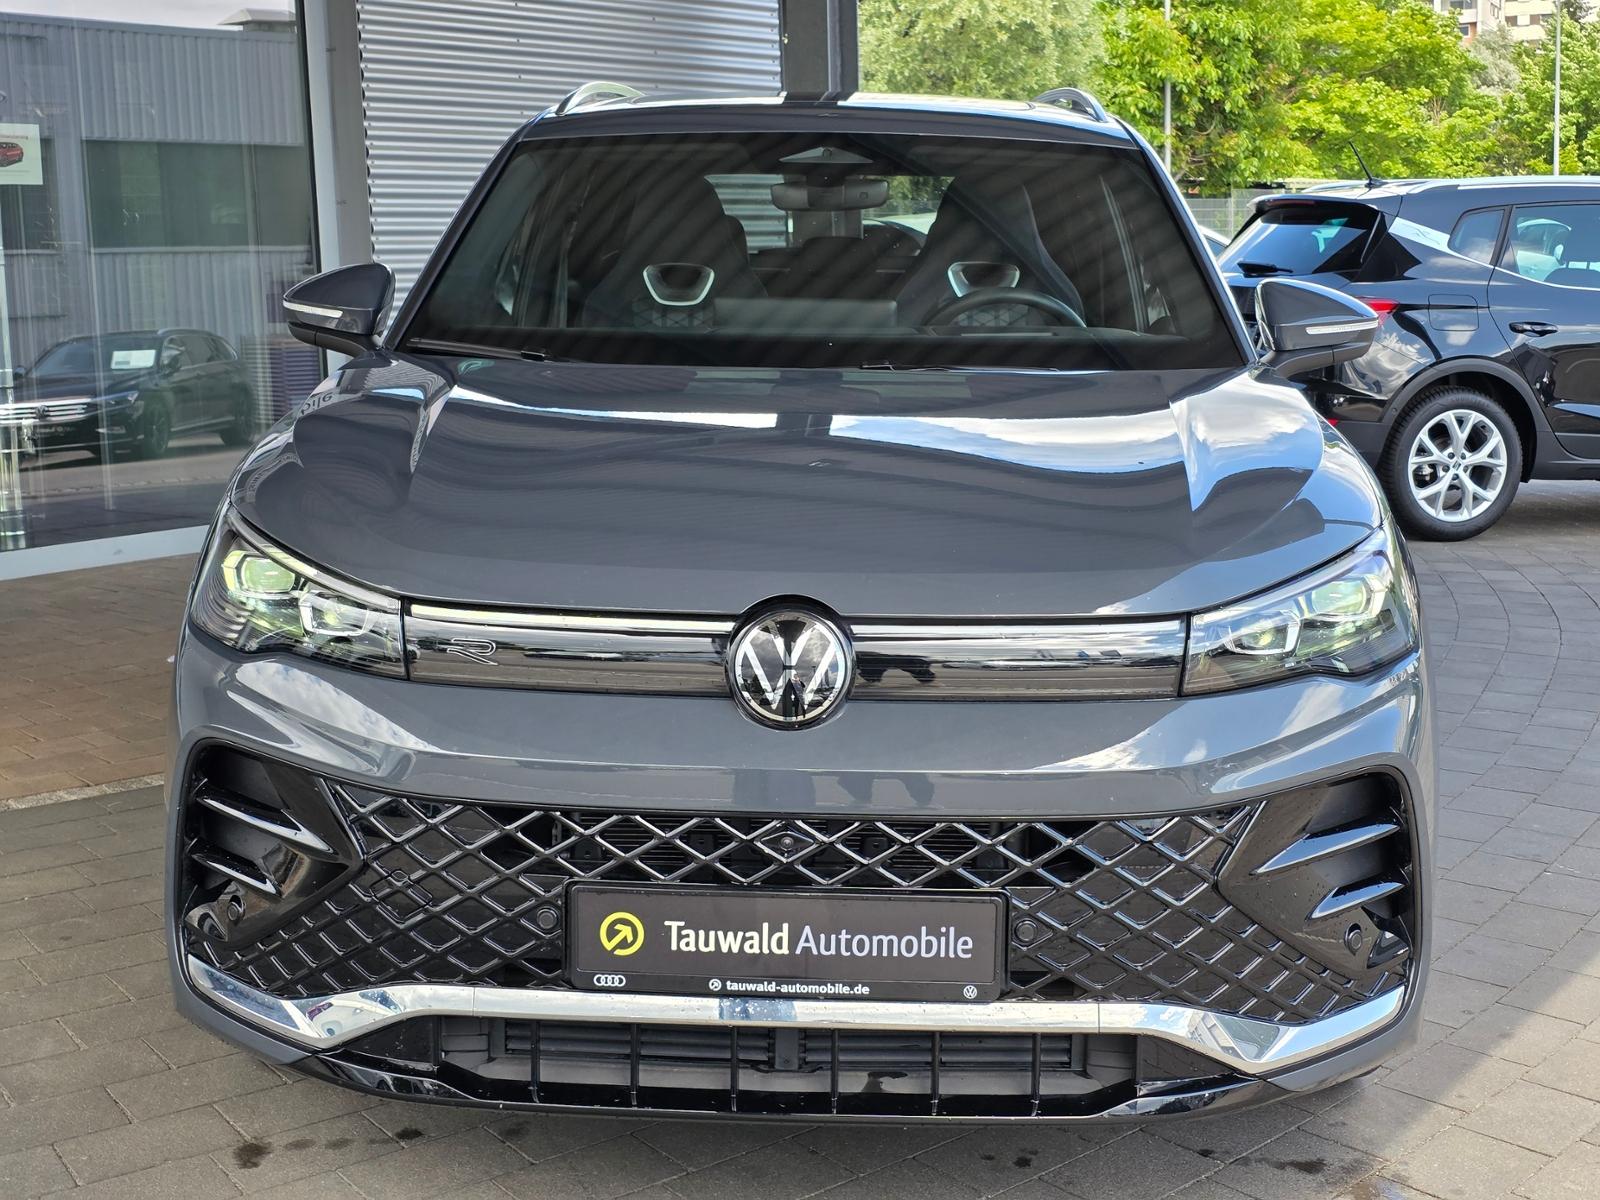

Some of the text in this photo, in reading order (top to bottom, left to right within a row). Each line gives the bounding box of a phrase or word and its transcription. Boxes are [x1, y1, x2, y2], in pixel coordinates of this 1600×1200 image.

[664, 921, 973, 959] Tauwald Automobile
[726, 980, 870, 995] tauwald-automobile.de
